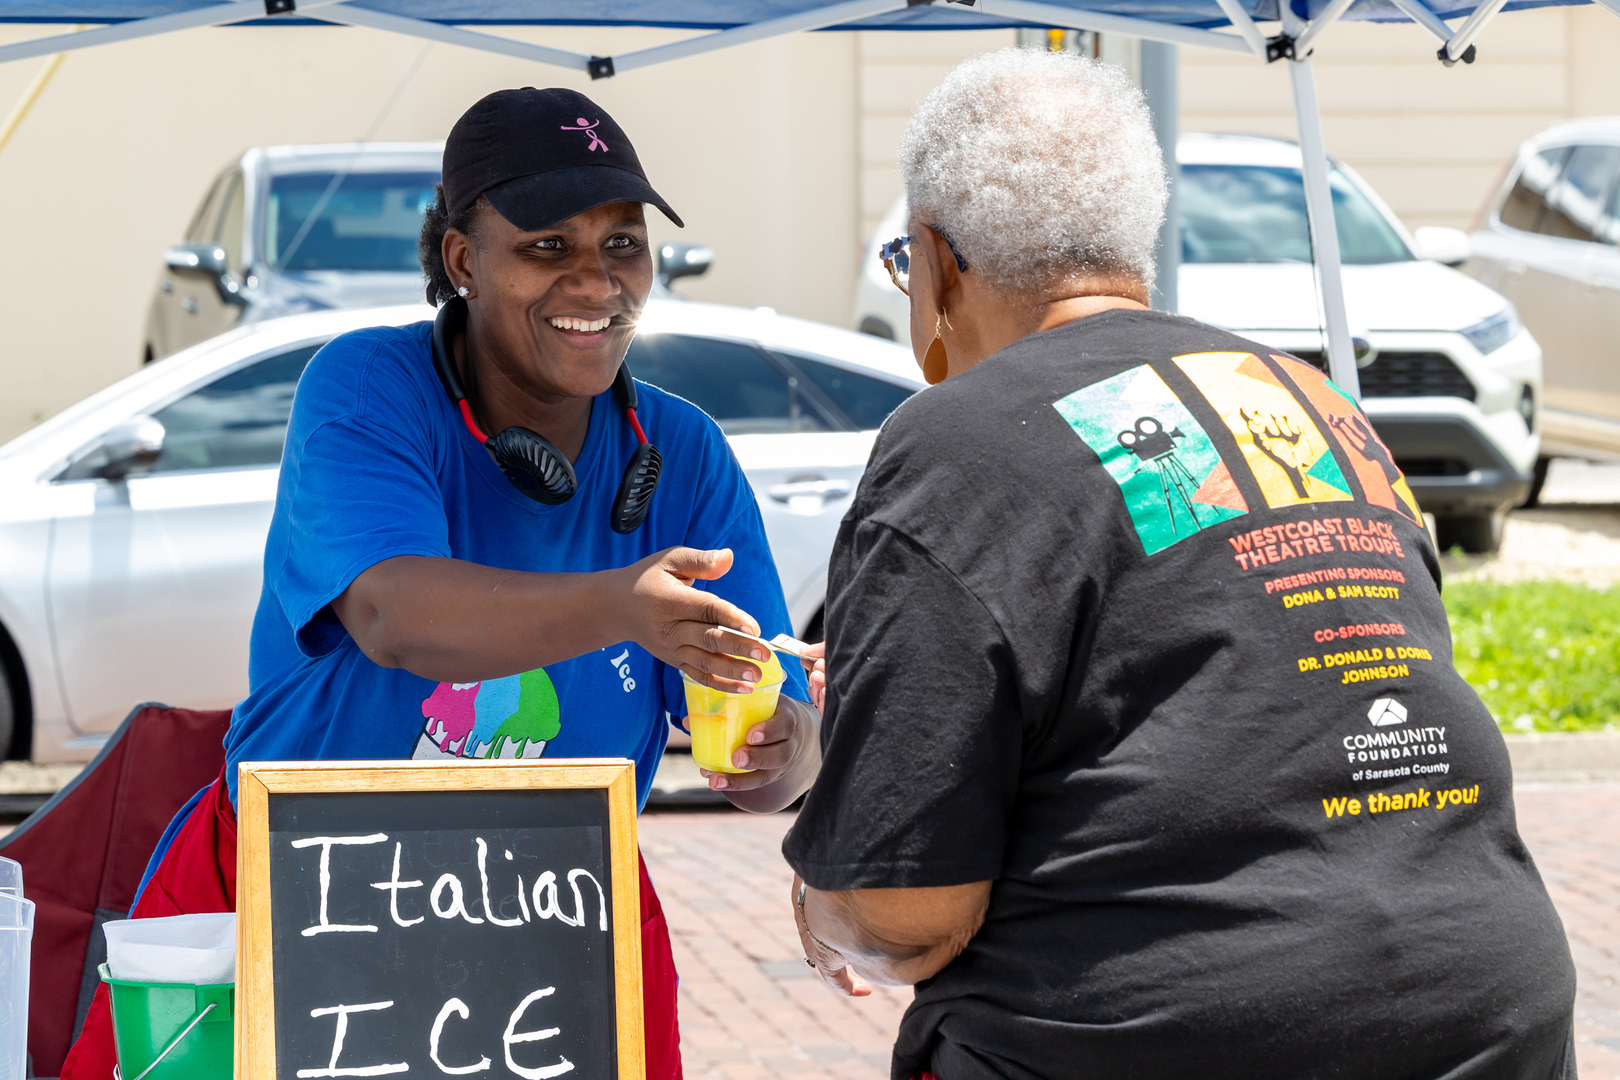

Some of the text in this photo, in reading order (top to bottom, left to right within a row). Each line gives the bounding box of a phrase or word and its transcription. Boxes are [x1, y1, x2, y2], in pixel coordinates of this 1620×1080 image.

[1228, 517, 1398, 553] WESTCOAST BLACK
[1234, 534, 1405, 571] THEATRE TROUPE
[1264, 567, 1406, 594] PRESENTING SPONSORS
[1282, 585, 1400, 608] DONA & SAM SCOTT
[1313, 623, 1406, 643] CO-SPONSORS
[610, 648, 636, 693] Ice
[1298, 646, 1433, 672] DR. DONALD & DORIS
[1341, 664, 1409, 684] JOHNSON
[1343, 727, 1446, 750] COMMUNITY
[1348, 743, 1448, 763] FOUNDATION
[1352, 762, 1450, 781] of Sarasota County
[1322, 784, 1480, 818] We thank you!
[290, 832, 608, 937] Italian
[296, 986, 575, 1080] ICE
